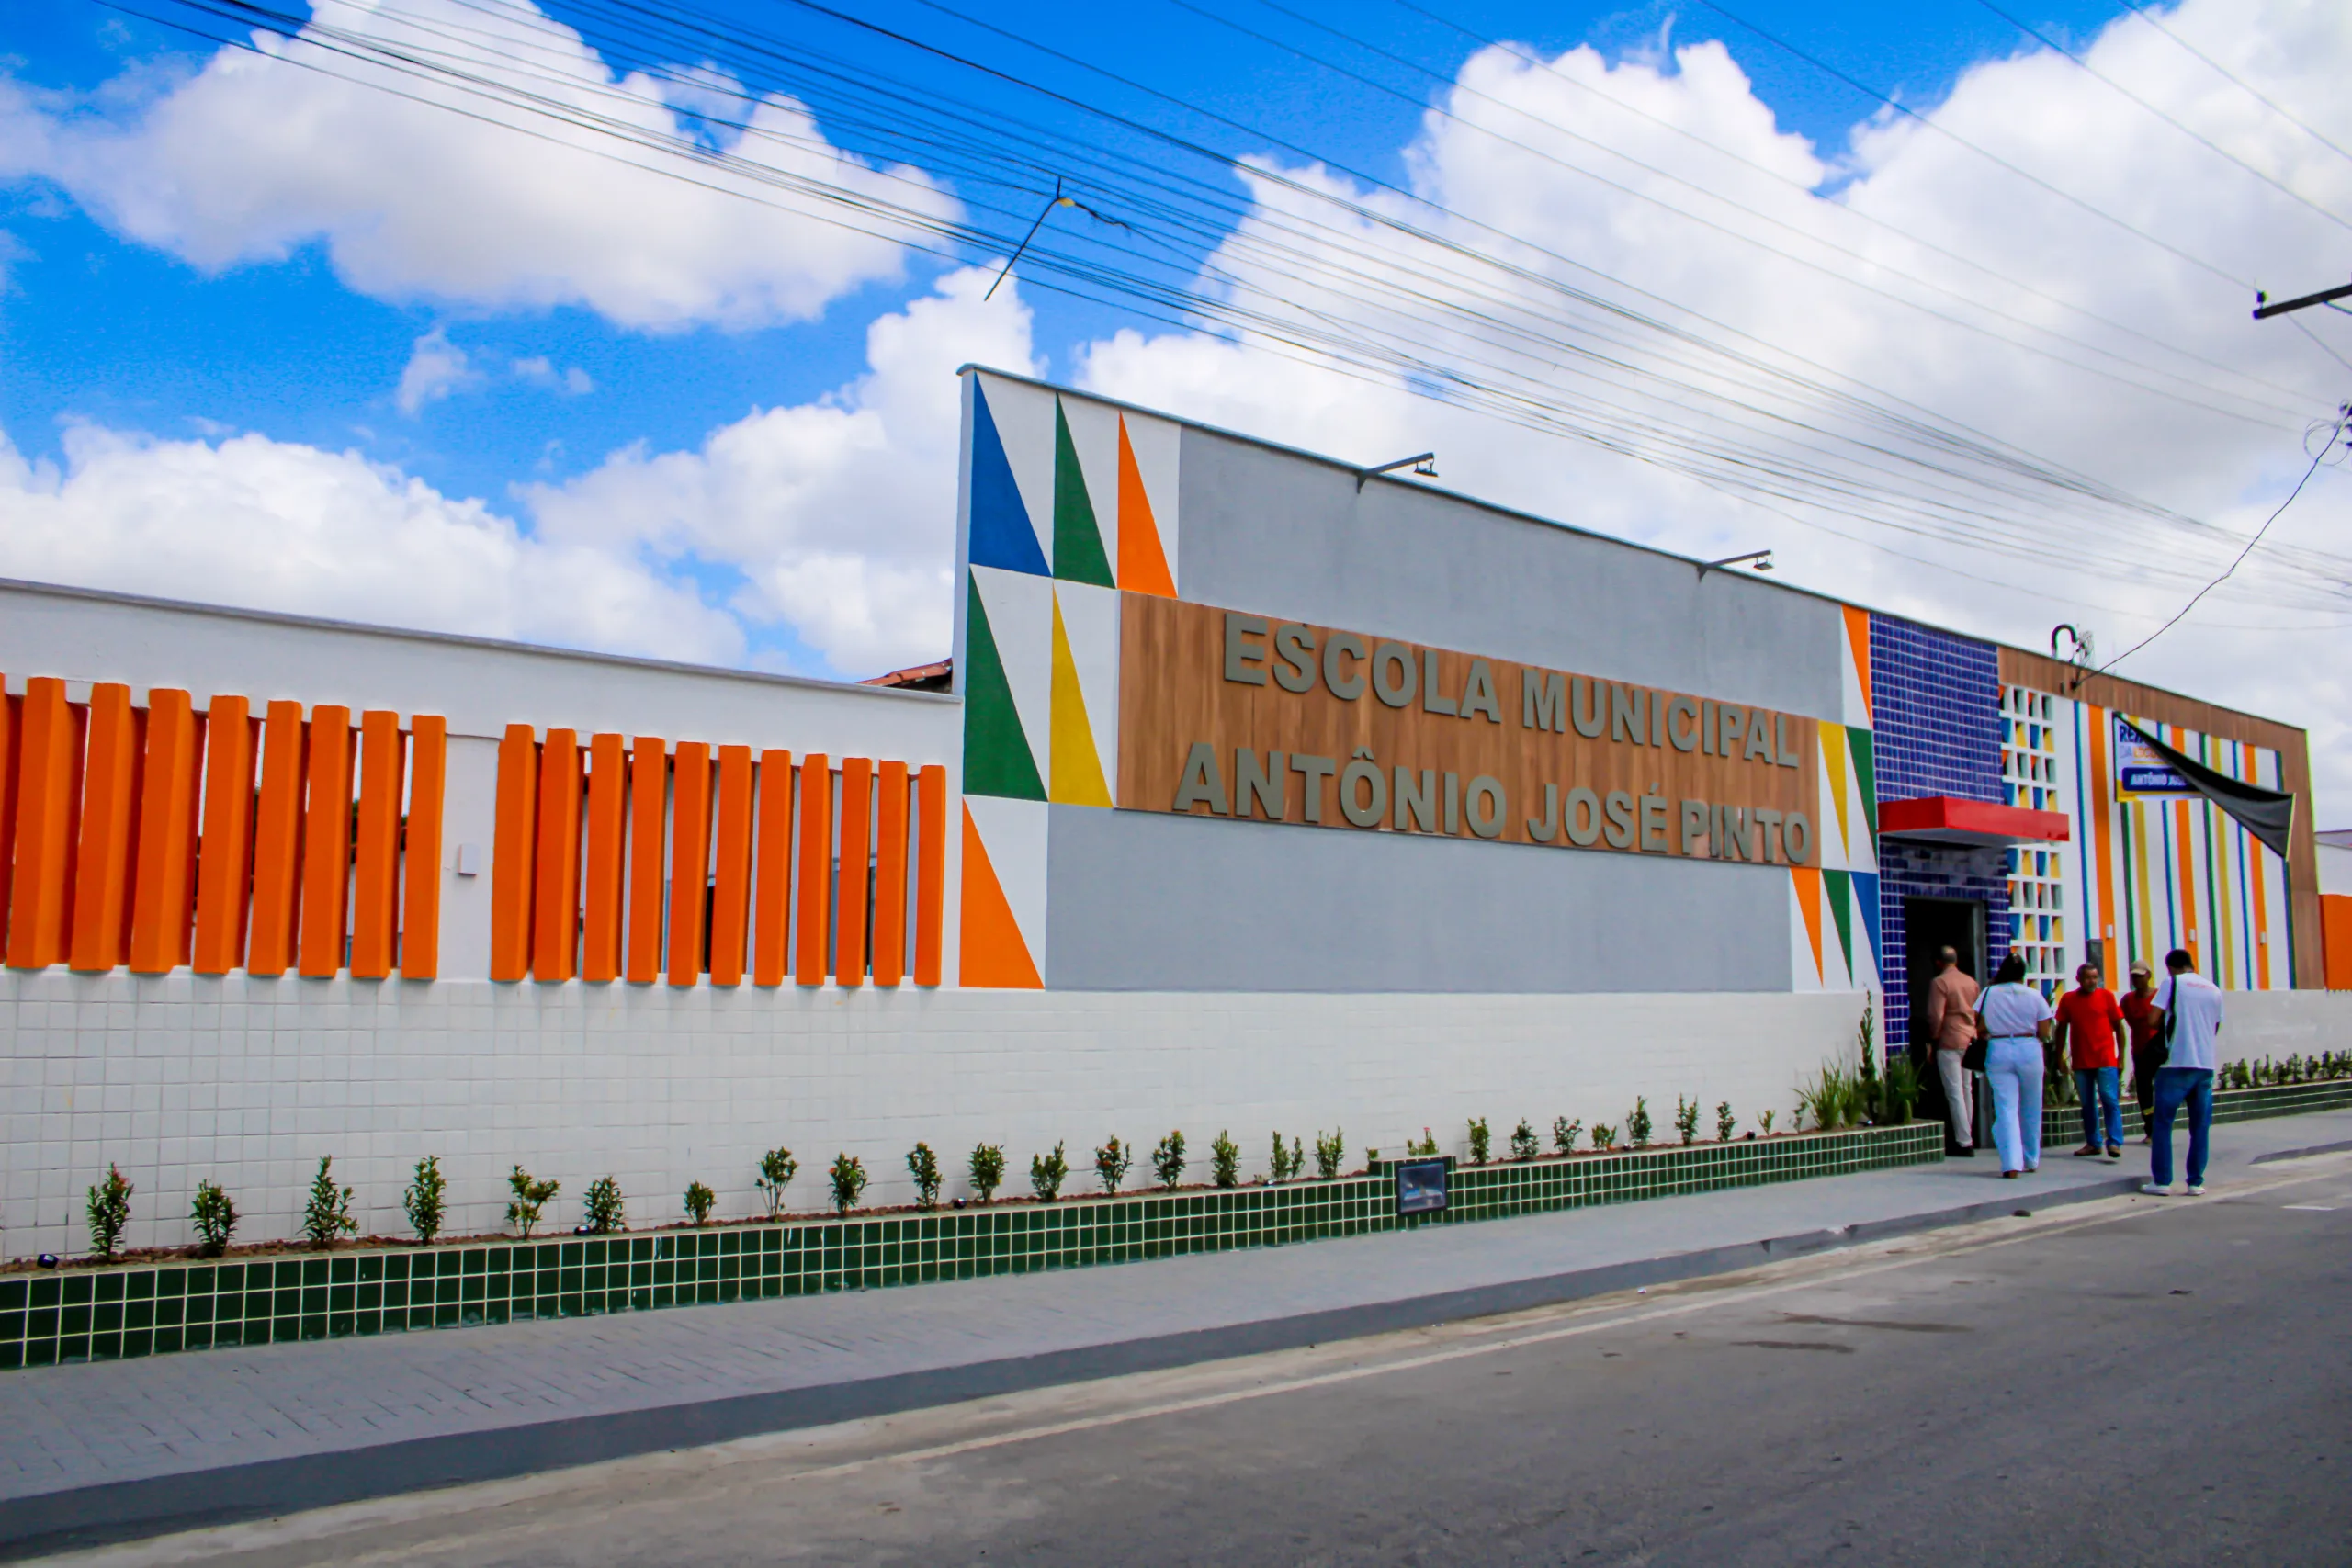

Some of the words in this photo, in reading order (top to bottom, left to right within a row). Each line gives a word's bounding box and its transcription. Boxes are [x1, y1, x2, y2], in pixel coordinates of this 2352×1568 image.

[1224, 612, 1501, 724] ESCOLA
[1522, 668, 1799, 769] MUNICIPAL
[1172, 742, 1508, 839] ANTÔNIO
[1527, 782, 1668, 853] JOSÉ
[1680, 799, 1812, 865] PINTO
